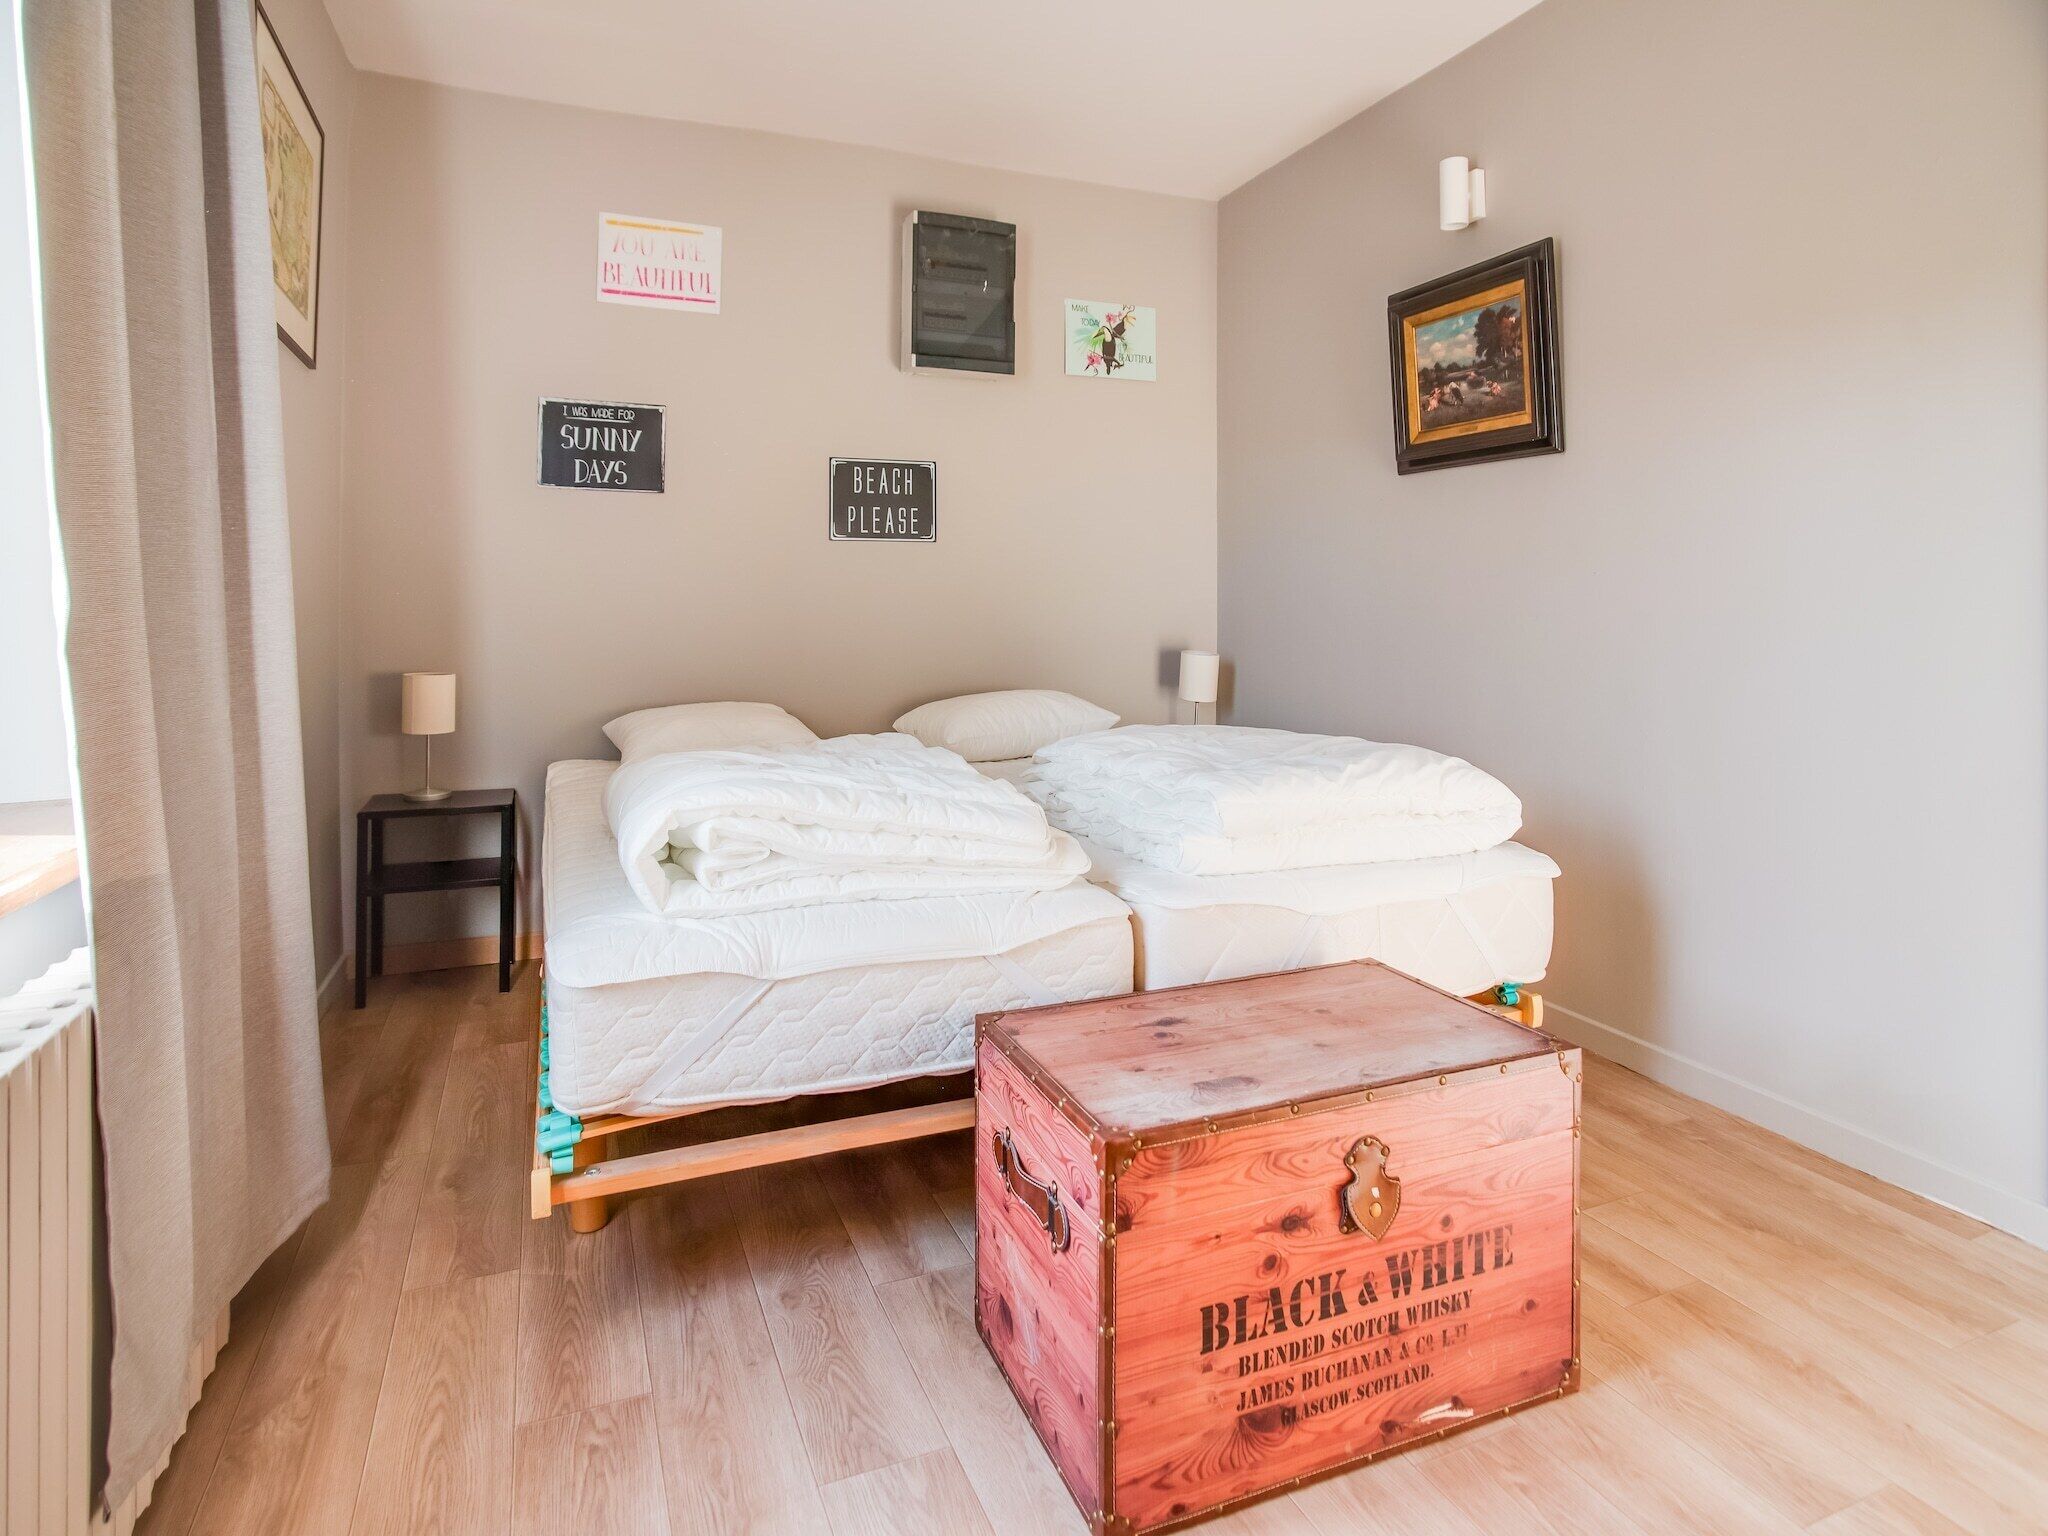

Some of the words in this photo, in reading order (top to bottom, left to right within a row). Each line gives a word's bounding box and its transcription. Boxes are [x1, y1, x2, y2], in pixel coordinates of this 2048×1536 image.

[602, 261, 717, 295] BEAUTIFUL
[563, 405, 568, 416] I
[571, 406, 589, 417] WAS
[591, 408, 615, 420] MADE
[617, 409, 636, 421] FOR
[560, 423, 643, 453] SUNNY
[574, 458, 628, 485] DAYS
[853, 466, 913, 495] BEACH
[847, 505, 919, 535] PLEASE
[1199, 1268, 1348, 1356] BLACK
[1357, 1270, 1379, 1306] &
[1385, 1223, 1514, 1300] WHITE
[1238, 1333, 1326, 1379] BLENDED
[1331, 1310, 1400, 1349] SCOTCH
[1406, 1289, 1473, 1326] WHISKY
[1236, 1376, 1295, 1413] JAMES
[1301, 1346, 1393, 1392] BUCHANAN
[1399, 1341, 1410, 1361] &
